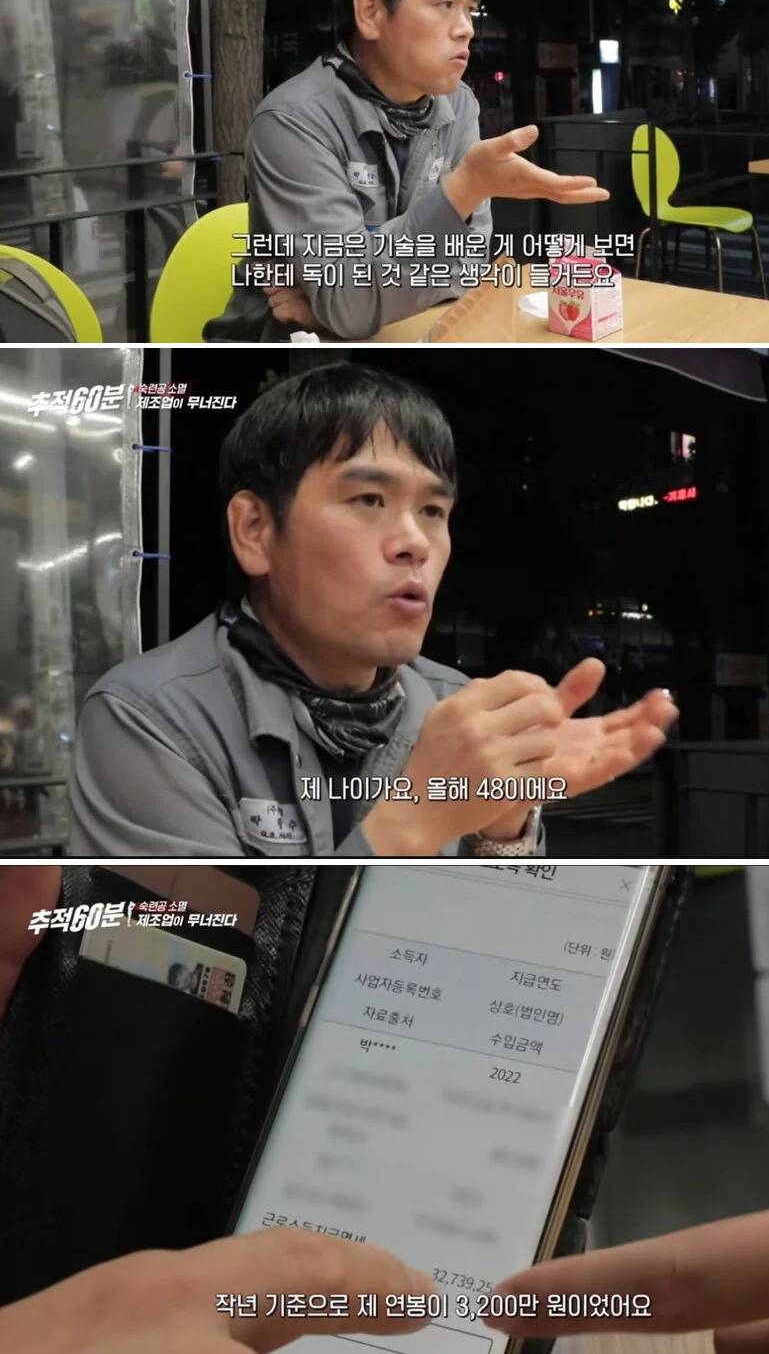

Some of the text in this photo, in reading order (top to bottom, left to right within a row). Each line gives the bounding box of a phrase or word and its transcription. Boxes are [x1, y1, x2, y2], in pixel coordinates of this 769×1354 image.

[389, 947, 429, 966] 소득자
[353, 972, 443, 1001] 사업자등록번호
[509, 970, 563, 992] 지급연도
[362, 1005, 415, 1028] 자료출처
[488, 998, 566, 1027] 상호(법인명)
[489, 1033, 545, 1055] 수입금액
[489, 1066, 522, 1084] 2022
